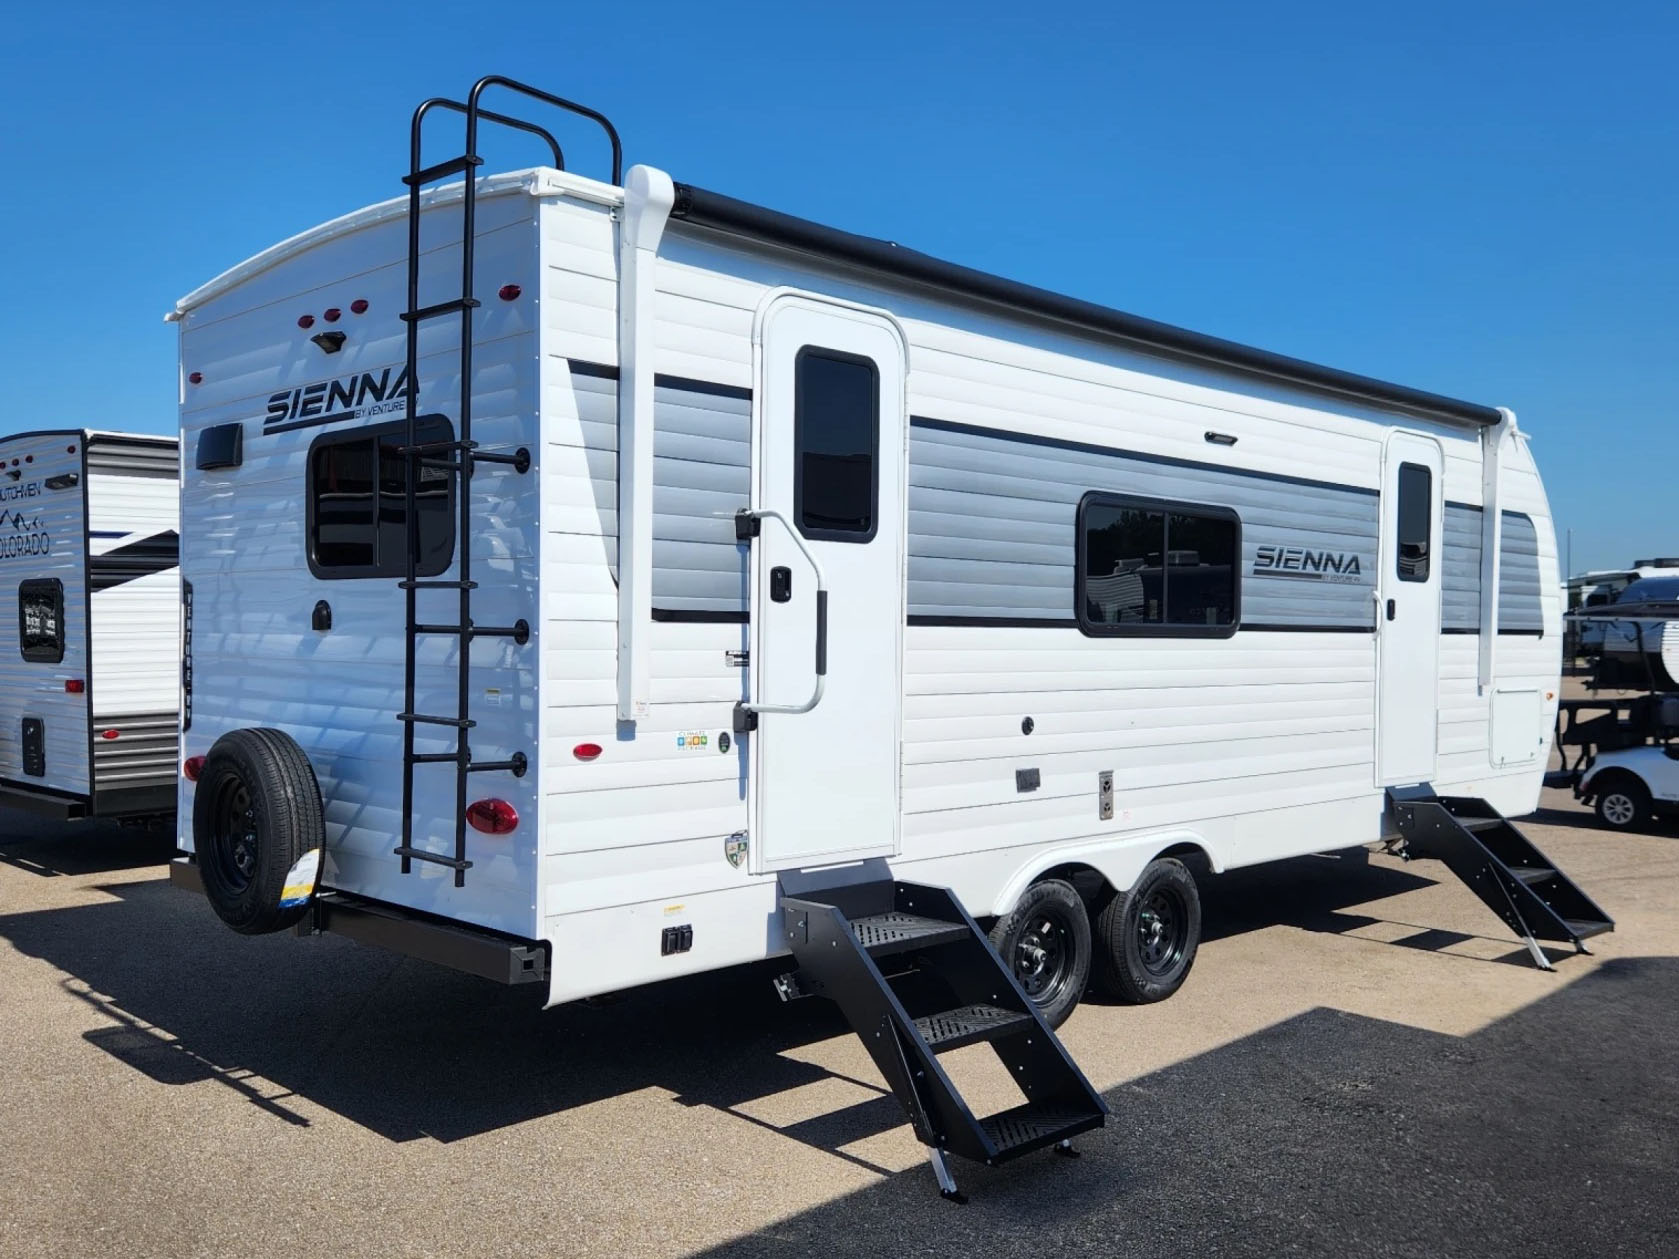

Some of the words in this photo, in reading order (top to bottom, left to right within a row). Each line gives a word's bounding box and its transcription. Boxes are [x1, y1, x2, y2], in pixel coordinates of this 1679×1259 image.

[264, 364, 420, 425] SIENNA
[355, 407, 367, 419] BY
[368, 400, 405, 416] VENTURE
[0, 483, 41, 500] UTCHMEN
[1253, 545, 1361, 575] SIENNA
